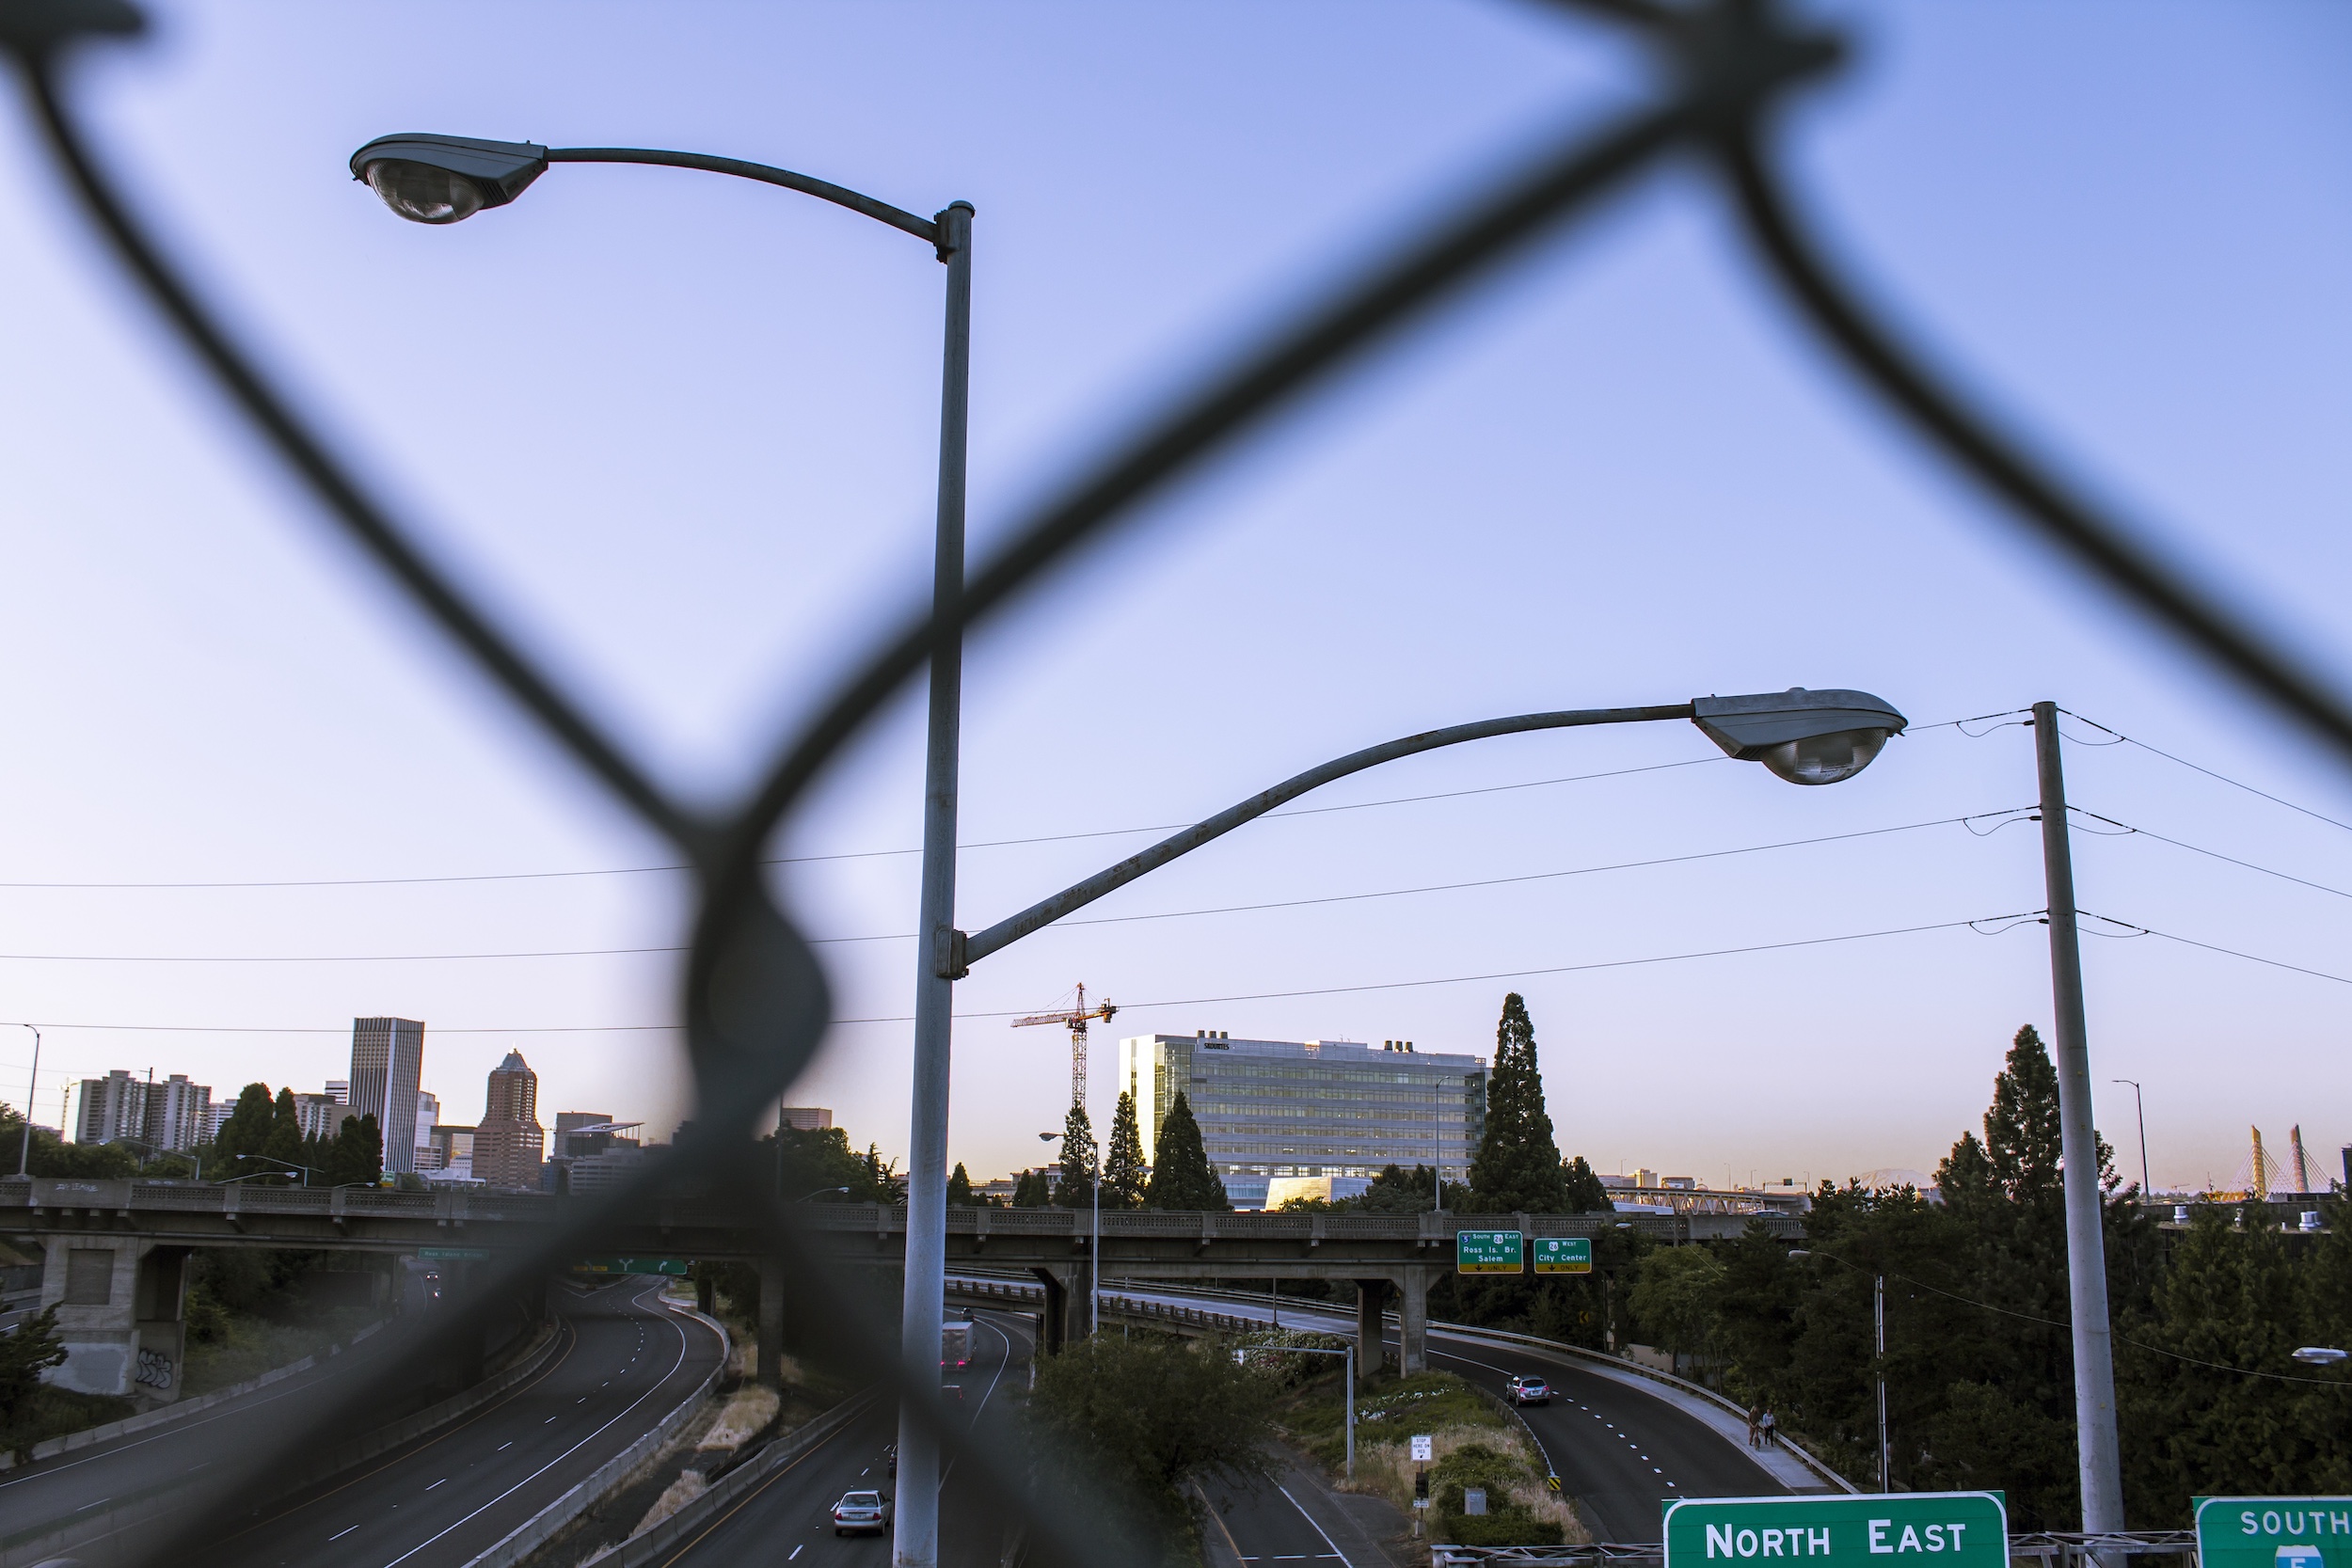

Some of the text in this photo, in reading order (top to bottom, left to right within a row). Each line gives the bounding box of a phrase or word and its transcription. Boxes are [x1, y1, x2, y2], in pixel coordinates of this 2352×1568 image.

[1549, 1242, 1558, 1250] 26
[1538, 1254, 1554, 1262] City
[2241, 1511, 2350, 1534] SOUTH
[1706, 1519, 1965, 1559] NORTH EAST
